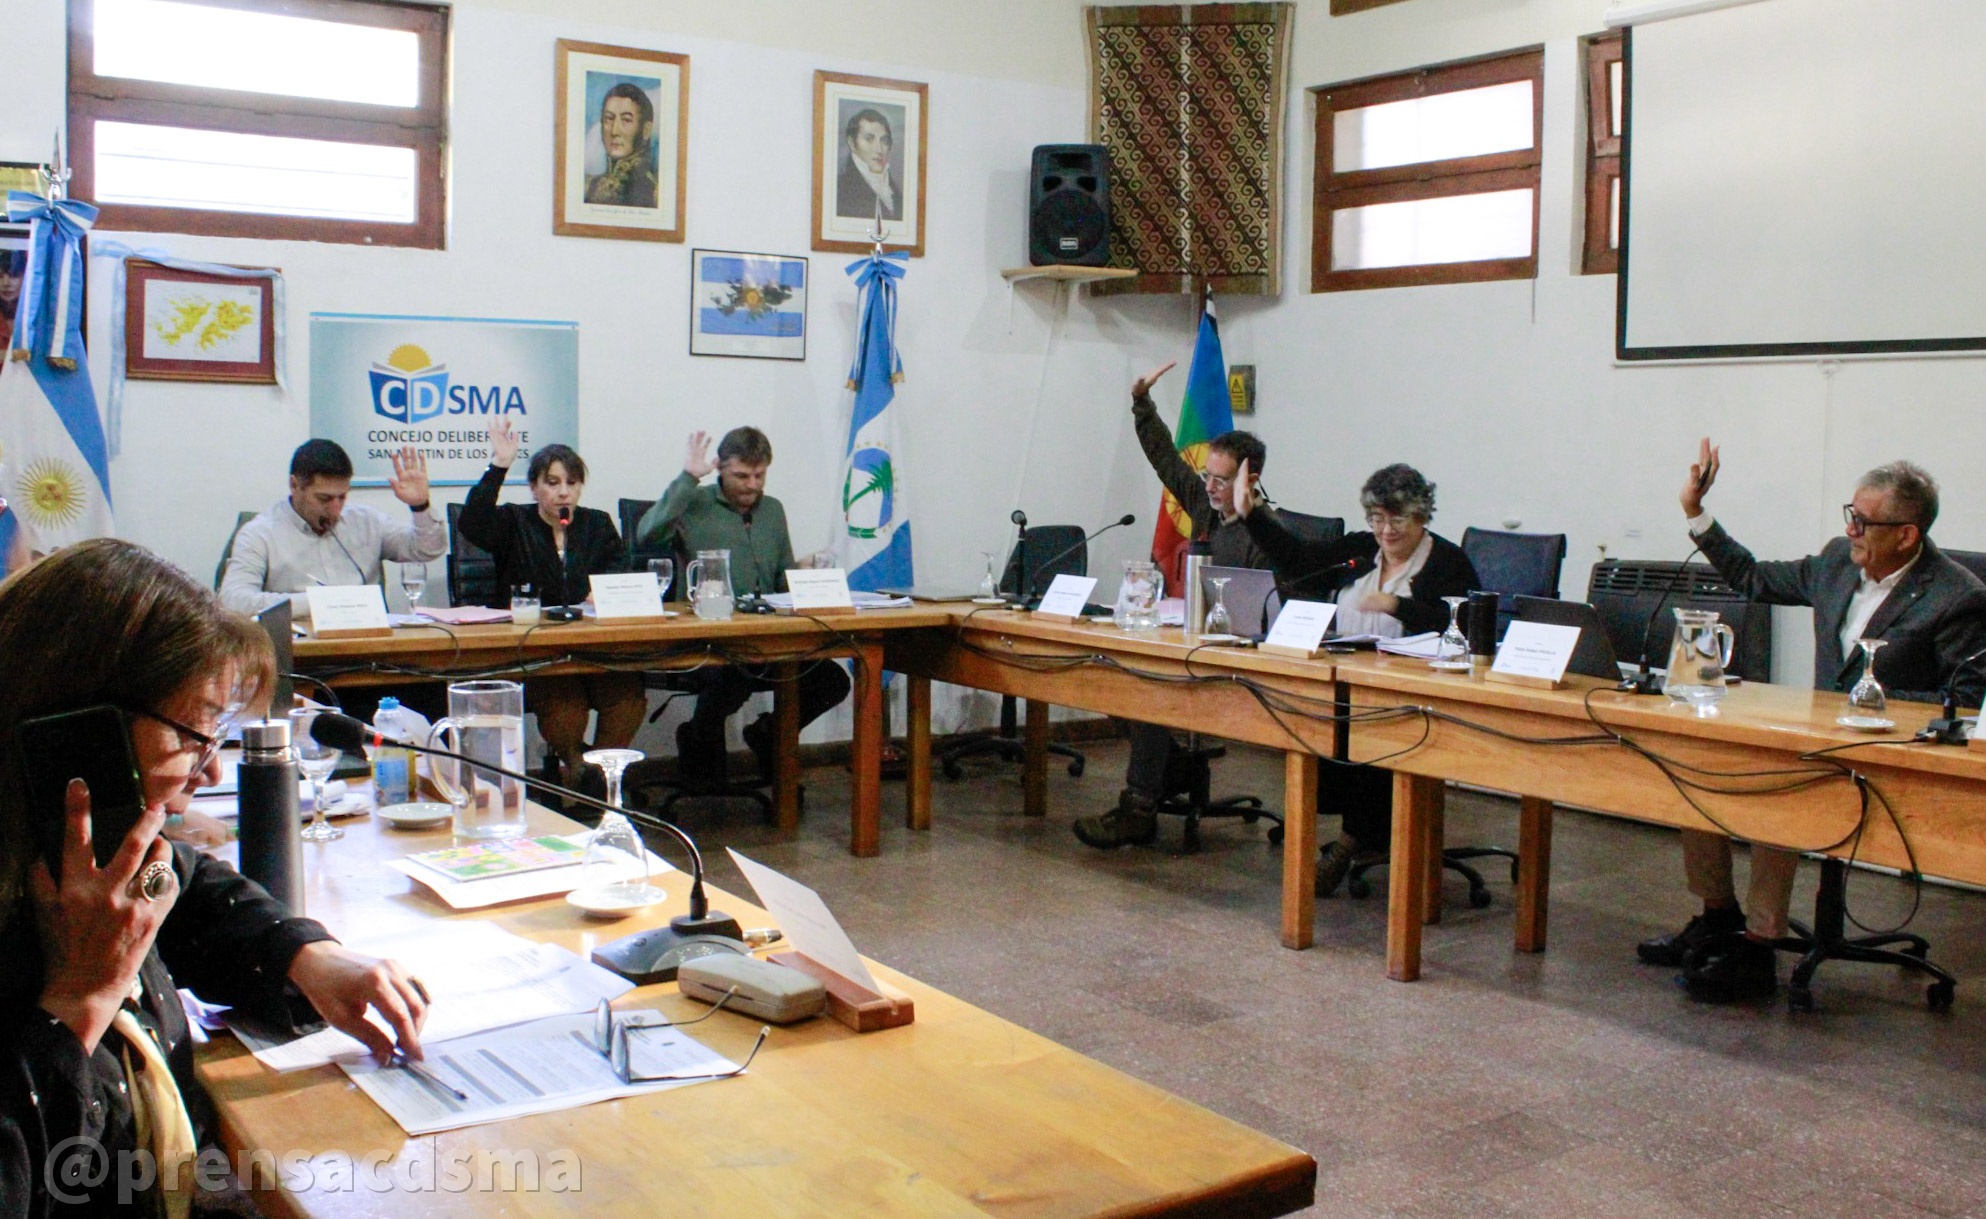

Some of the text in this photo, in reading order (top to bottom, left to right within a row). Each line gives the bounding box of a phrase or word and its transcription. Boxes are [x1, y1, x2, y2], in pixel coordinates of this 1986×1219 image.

[368, 430, 433, 443] CONCEJO
[368, 448, 393, 460] SAN
[448, 448, 464, 460] DE
[467, 448, 488, 460] LOS
